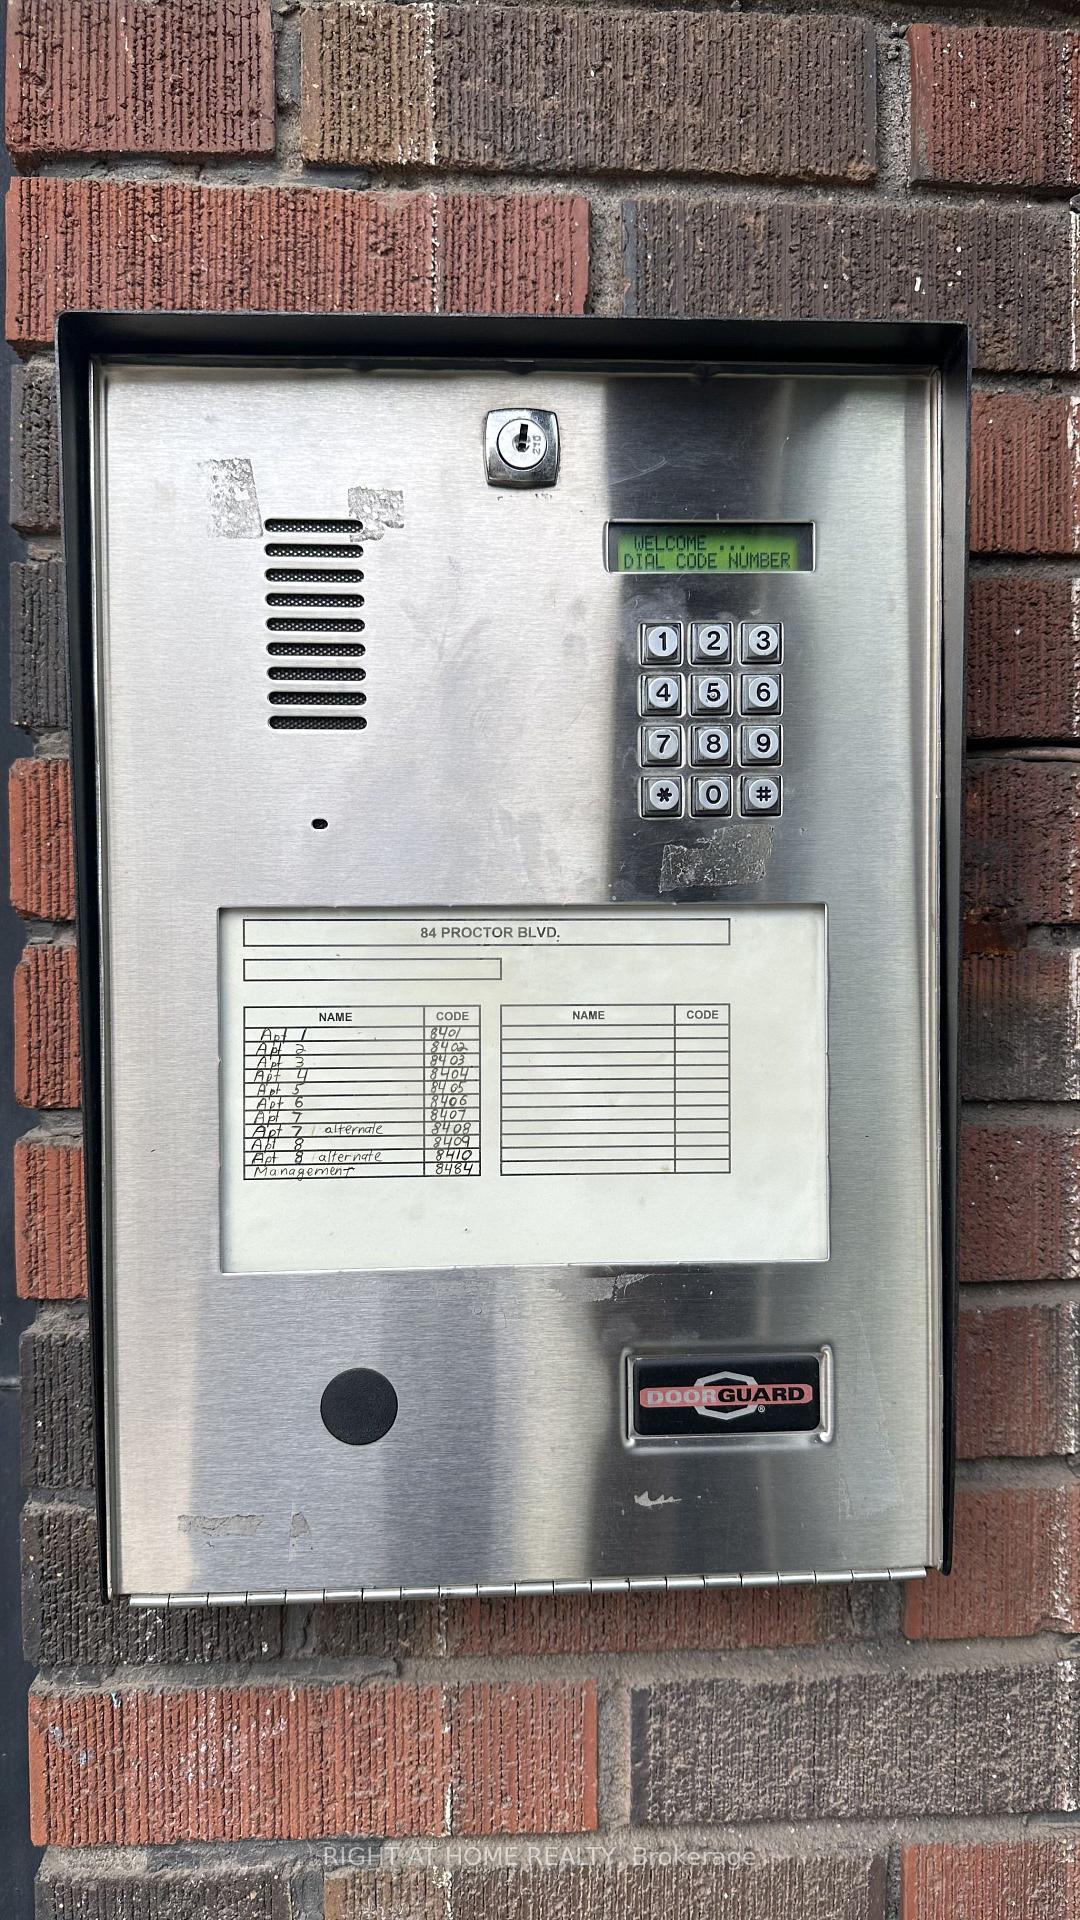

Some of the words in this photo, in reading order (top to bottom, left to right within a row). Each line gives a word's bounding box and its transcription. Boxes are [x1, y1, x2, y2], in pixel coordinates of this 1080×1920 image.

[634, 535, 707, 552] WELCOME
[624, 552, 665, 569] DIAL
[676, 552, 718, 569] CODE
[728, 552, 791, 568] NUMBER
[658, 632, 667, 651] 1
[706, 632, 721, 651] 2
[757, 631, 771, 651] 3
[655, 683, 671, 702] 4
[707, 683, 721, 702] 5
[757, 683, 771, 702] 6
[656, 734, 671, 754] 7
[706, 734, 721, 754] 8
[757, 734, 771, 753] 9
[706, 785, 721, 805] 0
[420, 927, 437, 939] 84
[441, 926, 513, 939] PROCTOR
[319, 1012, 353, 1021] NAME
[436, 1012, 469, 1021] CODE
[572, 1009, 606, 1020] NAME
[686, 1009, 719, 1020] CODE
[261, 1028, 287, 1044] Apt
[301, 1028, 307, 1041] 1
[430, 1027, 461, 1039] 8401
[256, 1042, 282, 1059] Apt
[295, 1044, 306, 1054] 2
[430, 1041, 468, 1052] 8402
[257, 1056, 282, 1071] Apt
[295, 1057, 304, 1067] 3
[430, 1055, 465, 1066] 8403
[254, 1069, 281, 1084] Apt
[297, 1068, 308, 1083] 4
[430, 1068, 469, 1080] 8404
[257, 1083, 281, 1099] Apt
[292, 1084, 300, 1095] 5
[430, 1082, 464, 1093] 8405
[256, 1097, 284, 1113] Apt
[295, 1098, 303, 1108] 6
[430, 1095, 468, 1108] 8406
[253, 1111, 280, 1127] Apt
[292, 1111, 303, 1124] 7
[430, 1108, 466, 1121] 8407
[252, 1125, 282, 1141] Apt
[292, 1126, 302, 1137] 7
[324, 1124, 383, 1135] alternate
[431, 1122, 471, 1134] 8408
[251, 1138, 276, 1153] Apt
[294, 1138, 304, 1151] 8
[432, 1136, 470, 1148] 8409
[252, 1152, 279, 1165] Apt
[295, 1153, 303, 1164] 8
[318, 1151, 383, 1163] alternate
[435, 1150, 472, 1161] 8410
[254, 1166, 355, 1181] Management
[435, 1163, 473, 1175] 8484
